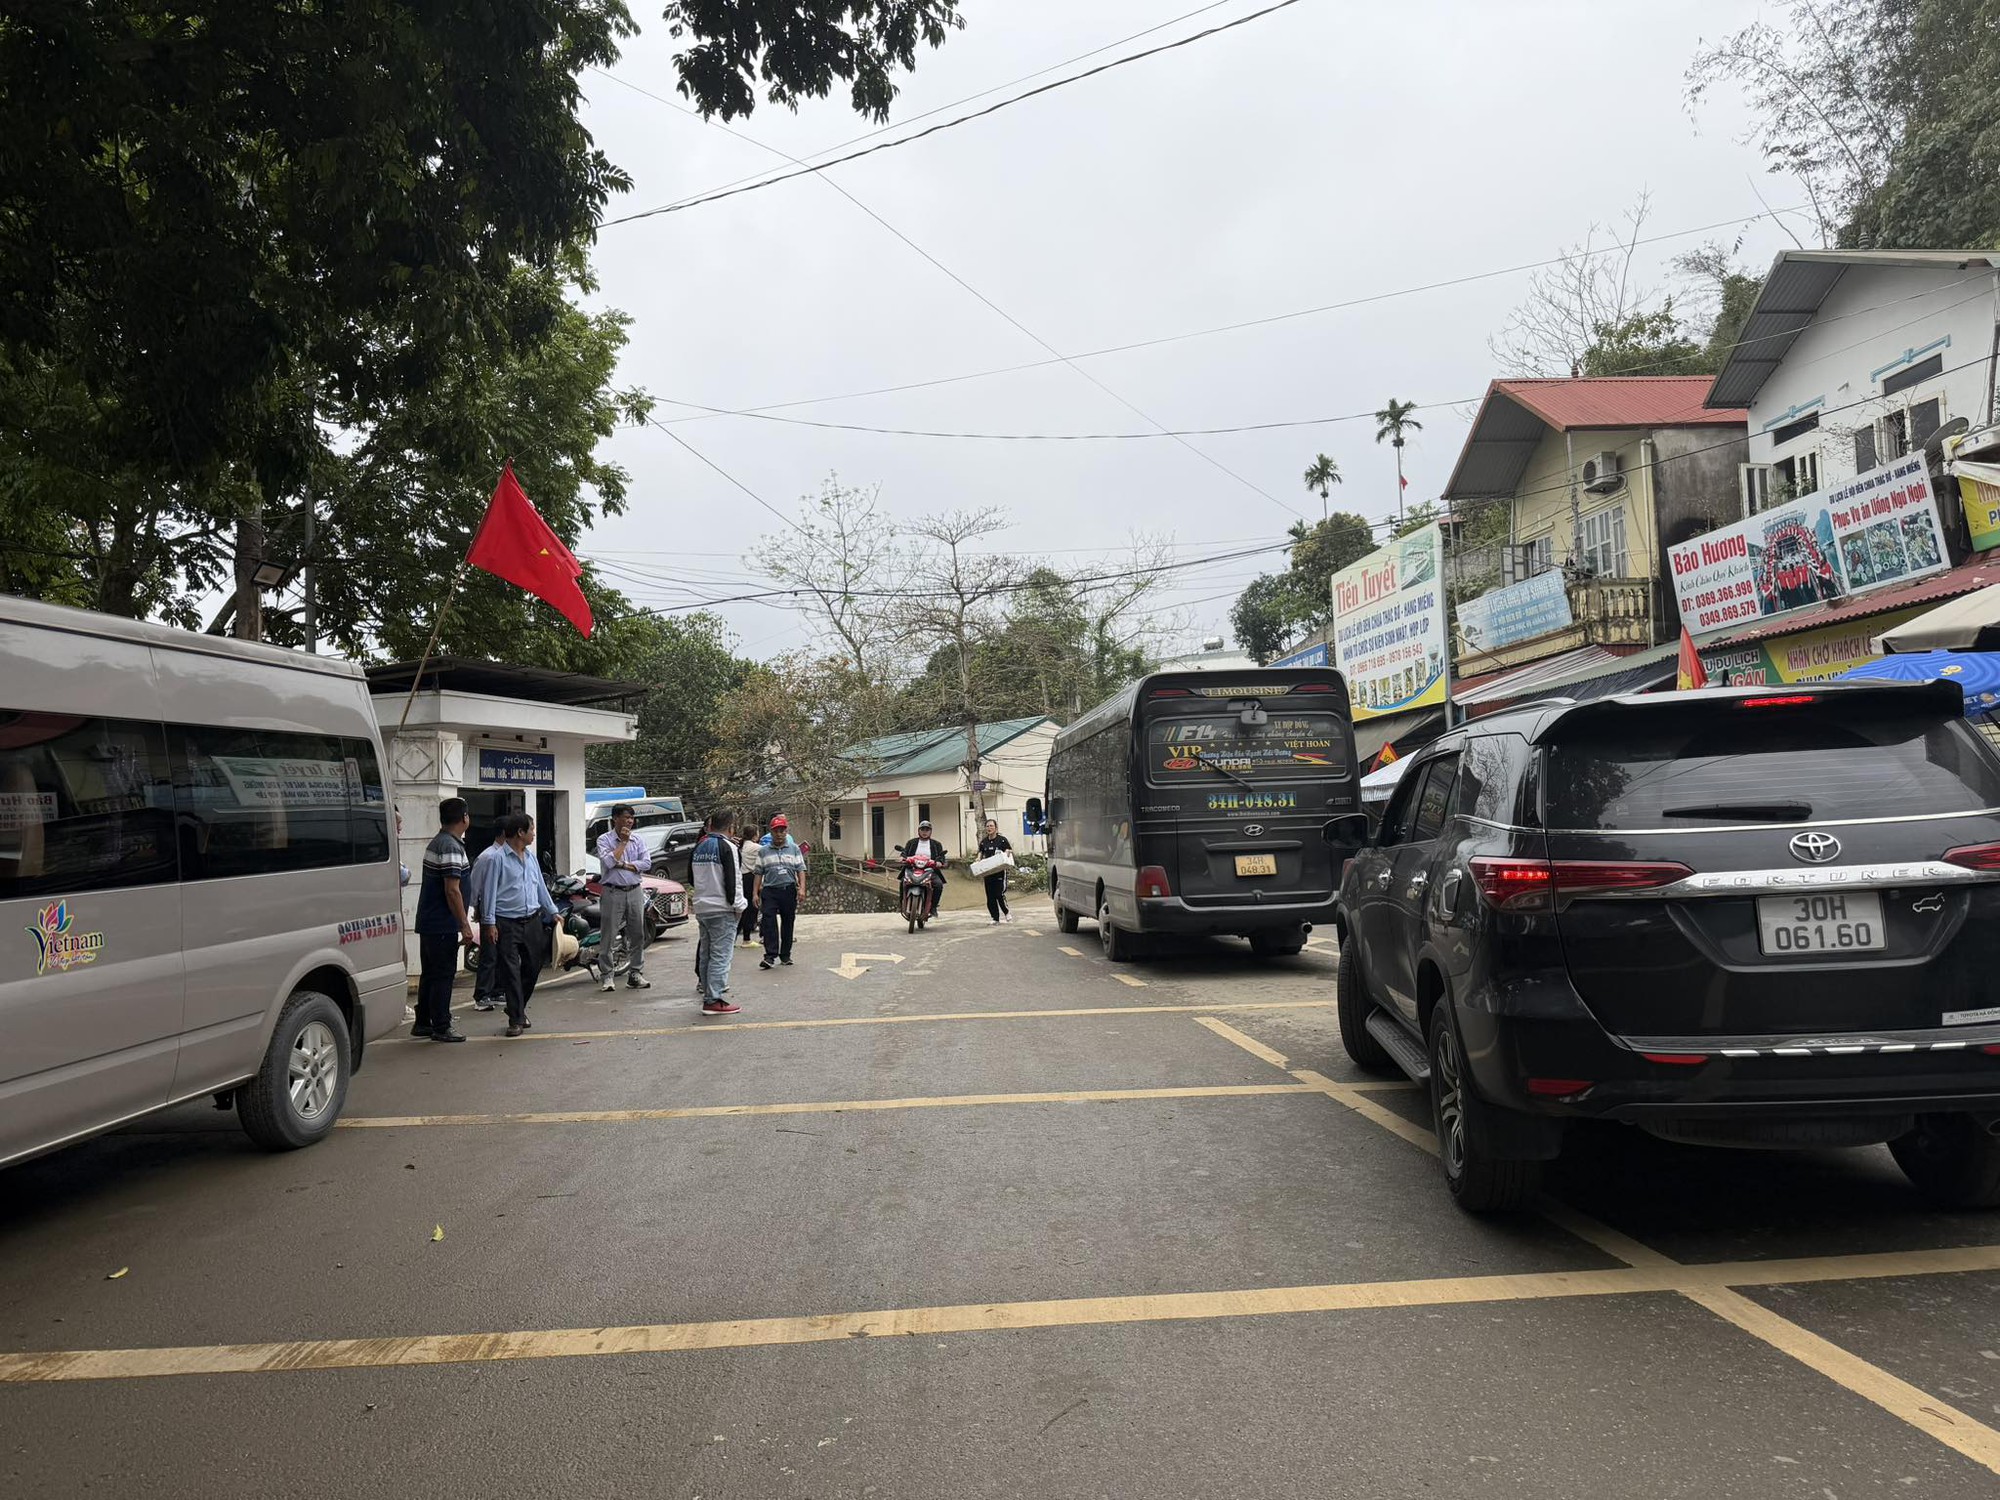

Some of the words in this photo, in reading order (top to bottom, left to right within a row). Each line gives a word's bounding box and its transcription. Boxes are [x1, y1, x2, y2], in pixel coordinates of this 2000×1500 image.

[1832, 512, 1850, 530] Phục
[1850, 506, 1861, 526] Vụ
[1861, 502, 1871, 520] ăn
[1870, 494, 1891, 516] Uống
[1890, 485, 1908, 509] Ngủ
[1906, 478, 1928, 502] Nghỉ
[1673, 546, 1699, 576] Bảo
[1700, 534, 1747, 566] Hương
[1335, 575, 1358, 613] Tiến
[1362, 556, 1396, 601] Tuyết
[1696, 580, 1753, 608] 0369.366.998
[1700, 600, 1757, 626] 0349.869.579
[1734, 651, 1758, 668] LỊCH
[1787, 645, 1810, 674] NHẬN
[1832, 635, 1860, 662] KHÁCH
[1208, 687, 1284, 696] LIMOUSINE
[1168, 746, 1202, 758] VIP
[1284, 740, 1304, 749] VIỆT
[1306, 739, 1330, 748] HOÀN
[1208, 792, 1296, 809] 34H-048.31
[1240, 866, 1272, 875] 048.31
[1246, 857, 1264, 866] 34H
[1702, 867, 1941, 888] FORTUNER
[1793, 896, 1848, 922] 30H
[1775, 923, 1872, 950] 061.60
